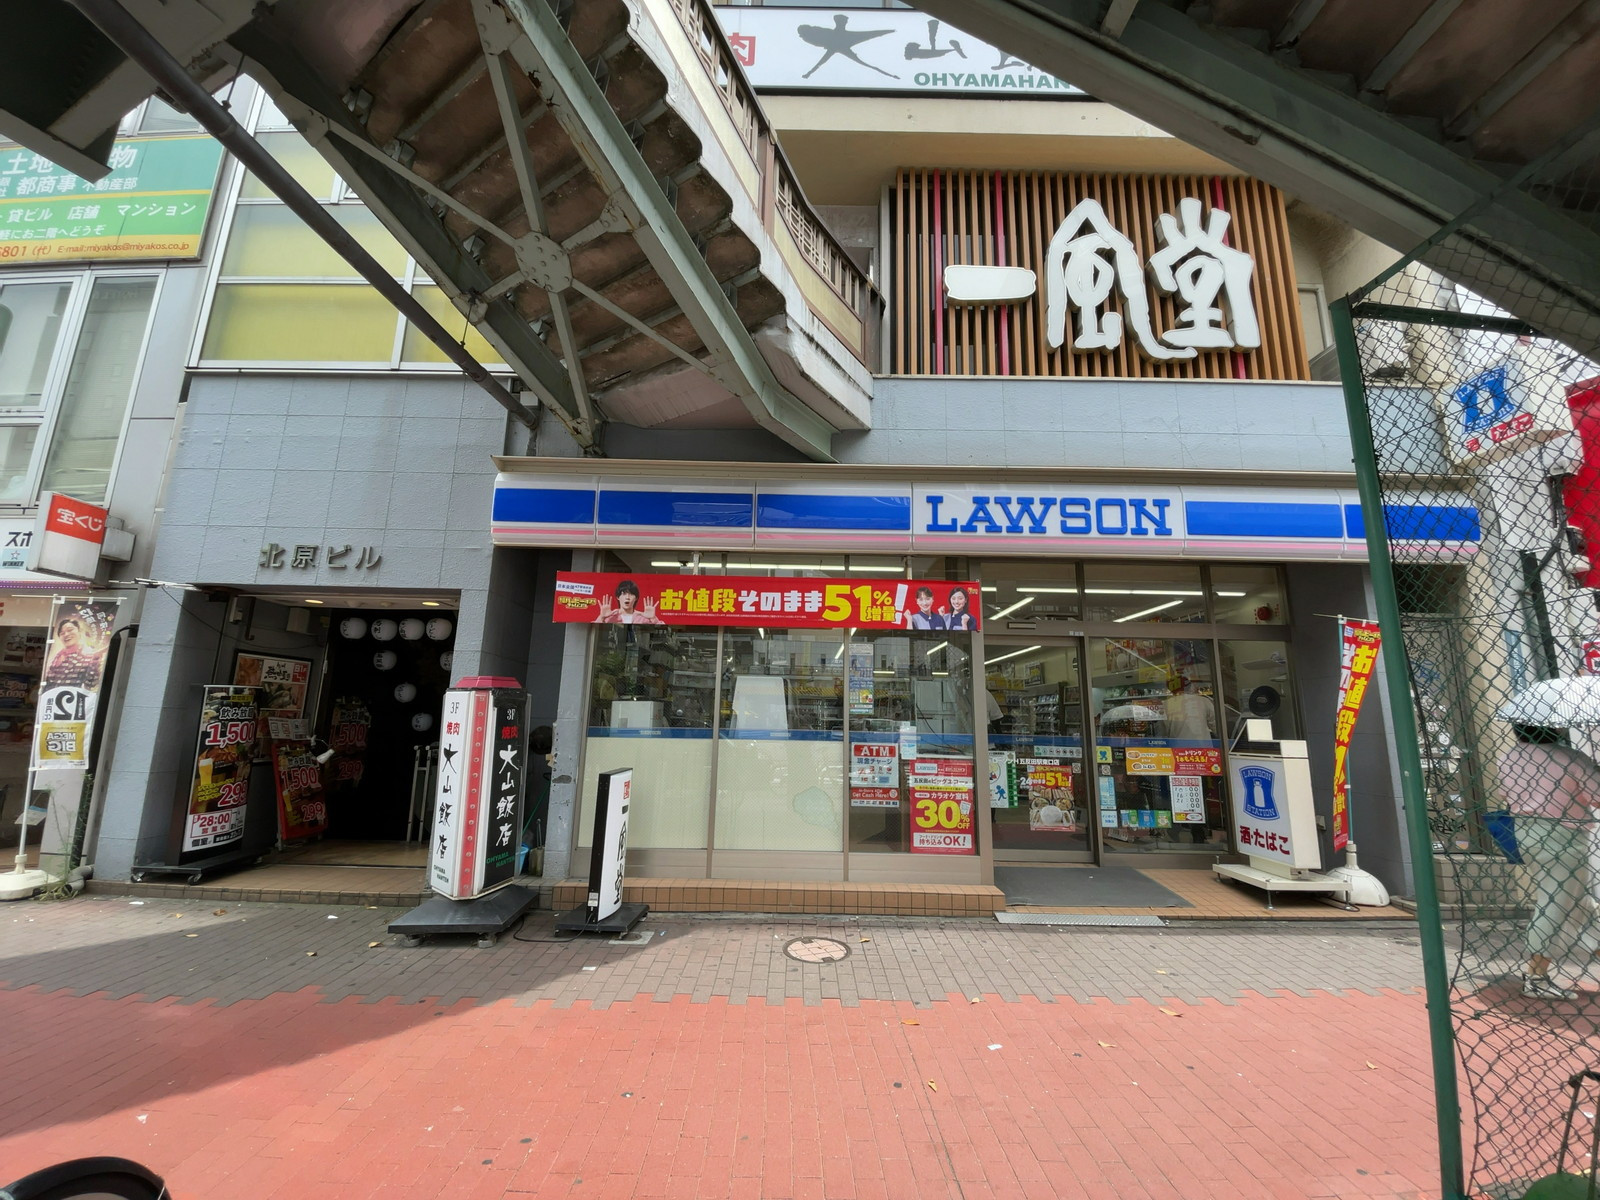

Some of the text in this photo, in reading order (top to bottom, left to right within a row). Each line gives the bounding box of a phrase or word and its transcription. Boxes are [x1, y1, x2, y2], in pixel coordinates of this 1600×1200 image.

[67, 205, 99, 220] 店舗
[117, 202, 196, 217] マンション
[944, 197, 1261, 361] 一風堂
[56, 508, 103, 532] 宝くじ
[926, 495, 1172, 536] LAWSON
[259, 542, 382, 570] 北原ビル
[450, 702, 459, 714] 3F
[507, 709, 516, 721] 3F
[446, 722, 461, 736] 焼肉
[860, 746, 889, 757] ATM
[1242, 768, 1273, 782] LAWSON
[1246, 803, 1276, 817] STATION
[199, 813, 230, 828] 28:00
